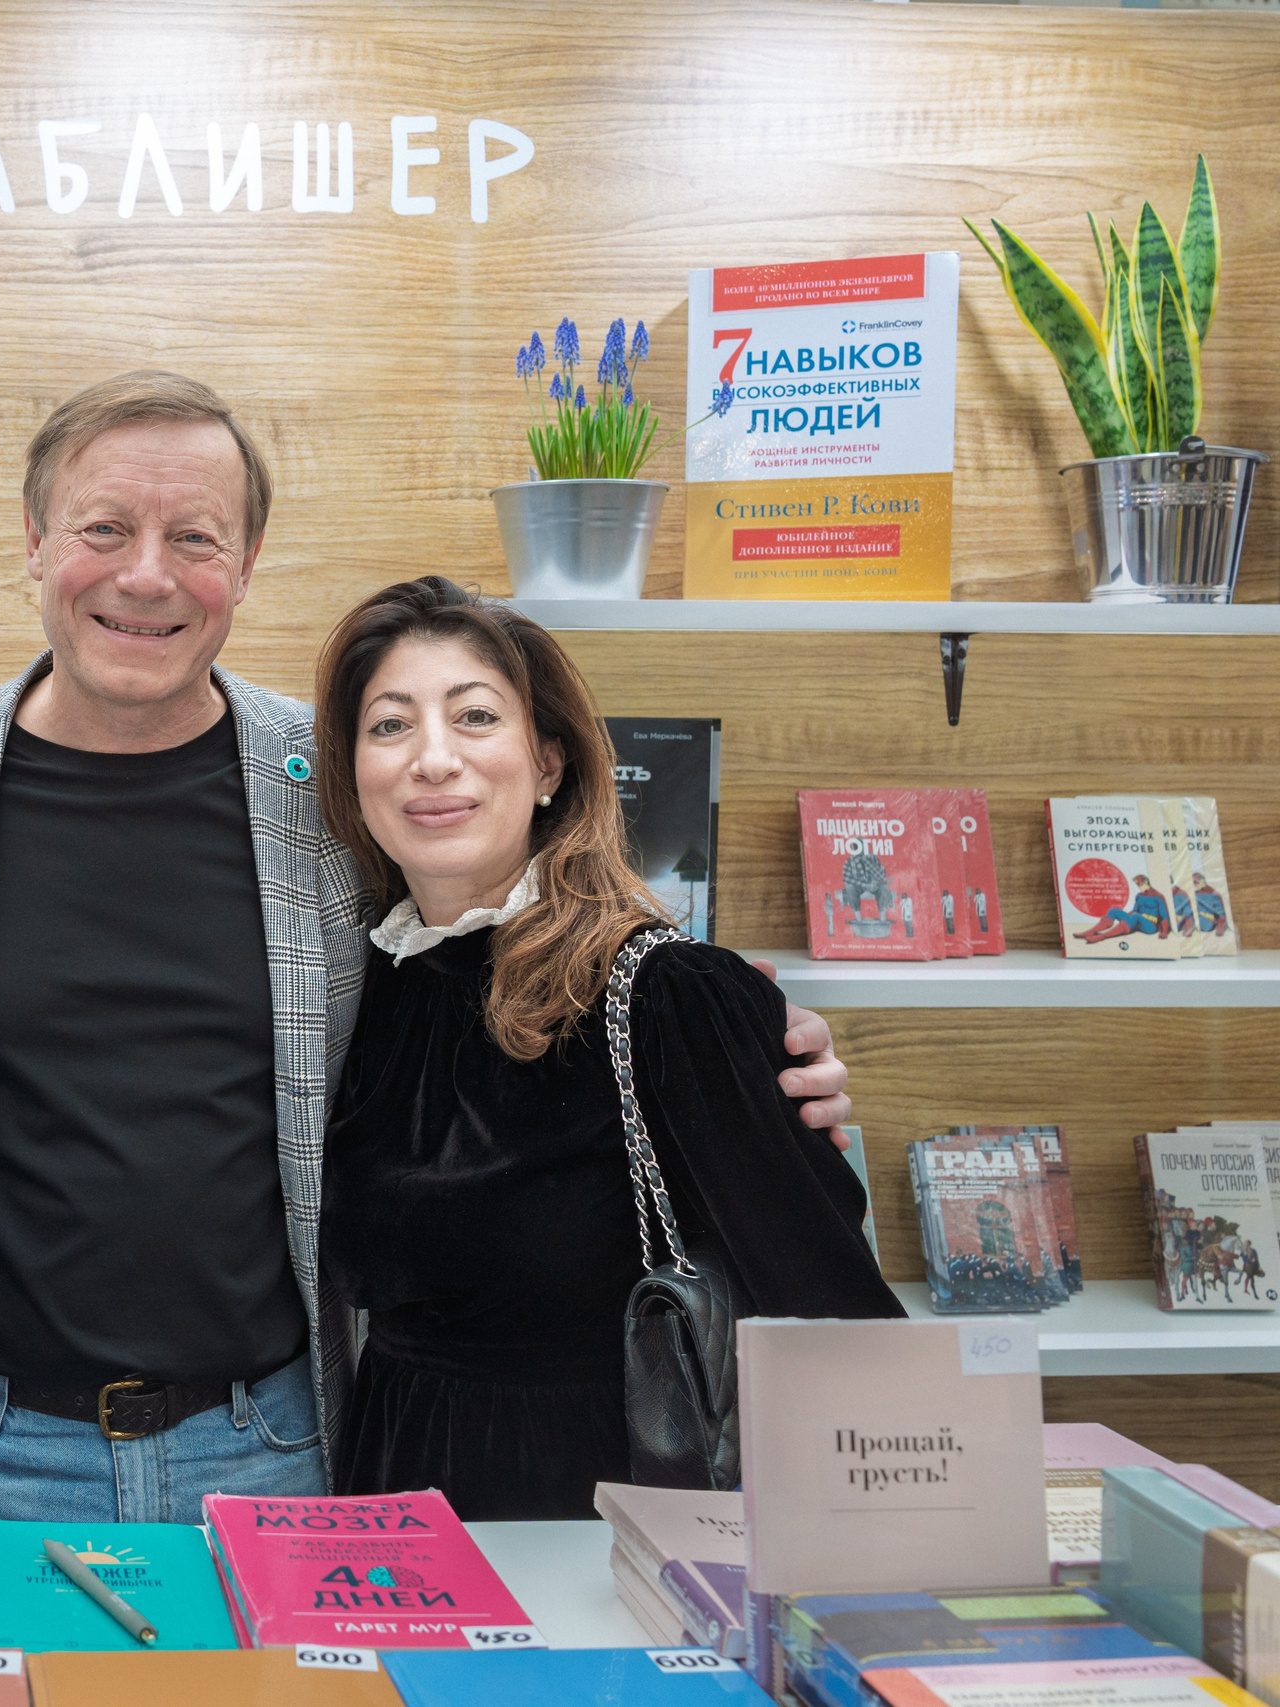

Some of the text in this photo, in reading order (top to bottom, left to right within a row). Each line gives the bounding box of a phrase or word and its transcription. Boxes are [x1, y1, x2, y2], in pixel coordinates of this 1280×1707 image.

[724, 285, 755, 295] БОЛЕЕ
[770, 279, 837, 292] МИЛЛИОНОВ
[839, 274, 914, 288] ЭКЗЕМПЛЯРОВ
[755, 286, 880, 303] ПРОДАНО ВО ВСЕМ МИРЕ
[859, 319, 923, 332] FranklinCovey
[712, 328, 922, 385] 7 НАВЫКОВ
[746, 396, 881, 436] ЛЮДЕЙ
[802, 443, 880, 455] ИНСТРУМЕНТЫ
[754, 456, 872, 468] РАЗВИТИЯ ЛИЧНОСТИ
[716, 498, 812, 520] Стивен
[851, 494, 920, 515] Кови
[776, 530, 855, 542] ЮБИЛЕЙНОЕ
[738, 542, 893, 556] ДОПОЛНЕННОЕ ИЗДАНИЕ
[633, 732, 648, 740] Ева
[816, 818, 905, 838] ПАЦИЕНТО
[1086, 816, 1130, 826] ЭПОХА
[1064, 829, 1154, 840] ВЫГОРАЮЩИХ
[832, 838, 894, 856] ЛОГИЯ
[1068, 842, 1154, 854] СУПЕРГЕРОЕВ
[924, 1150, 1018, 1169] ГРАД
[1161, 1153, 1256, 1171] ПОЧЕМУ РОССИЯ
[1201, 1174, 1258, 1192] ОТСТАЛА?
[835, 1427, 964, 1458] Прощай,
[847, 1457, 949, 1492] грусть!
[250, 1502, 412, 1514] ТРЕНАЖЕР
[256, 1514, 432, 1531] МОЗГА
[696, 1516, 746, 1528] Про
[336, 1540, 416, 1548] РАЗВИТЬ
[288, 1554, 403, 1562] МЫШЛЕНИЯ
[38, 1565, 147, 1580] ТРАЖЕР
[102, 1580, 164, 1588] РИВЫЧЕК
[313, 1586, 456, 1610] ДНЕЙ
[334, 1622, 458, 1634] ГАРЕТ МУР
[474, 1630, 532, 1644] 450
[298, 1650, 362, 1664] 600
[654, 1654, 720, 1668] 600
